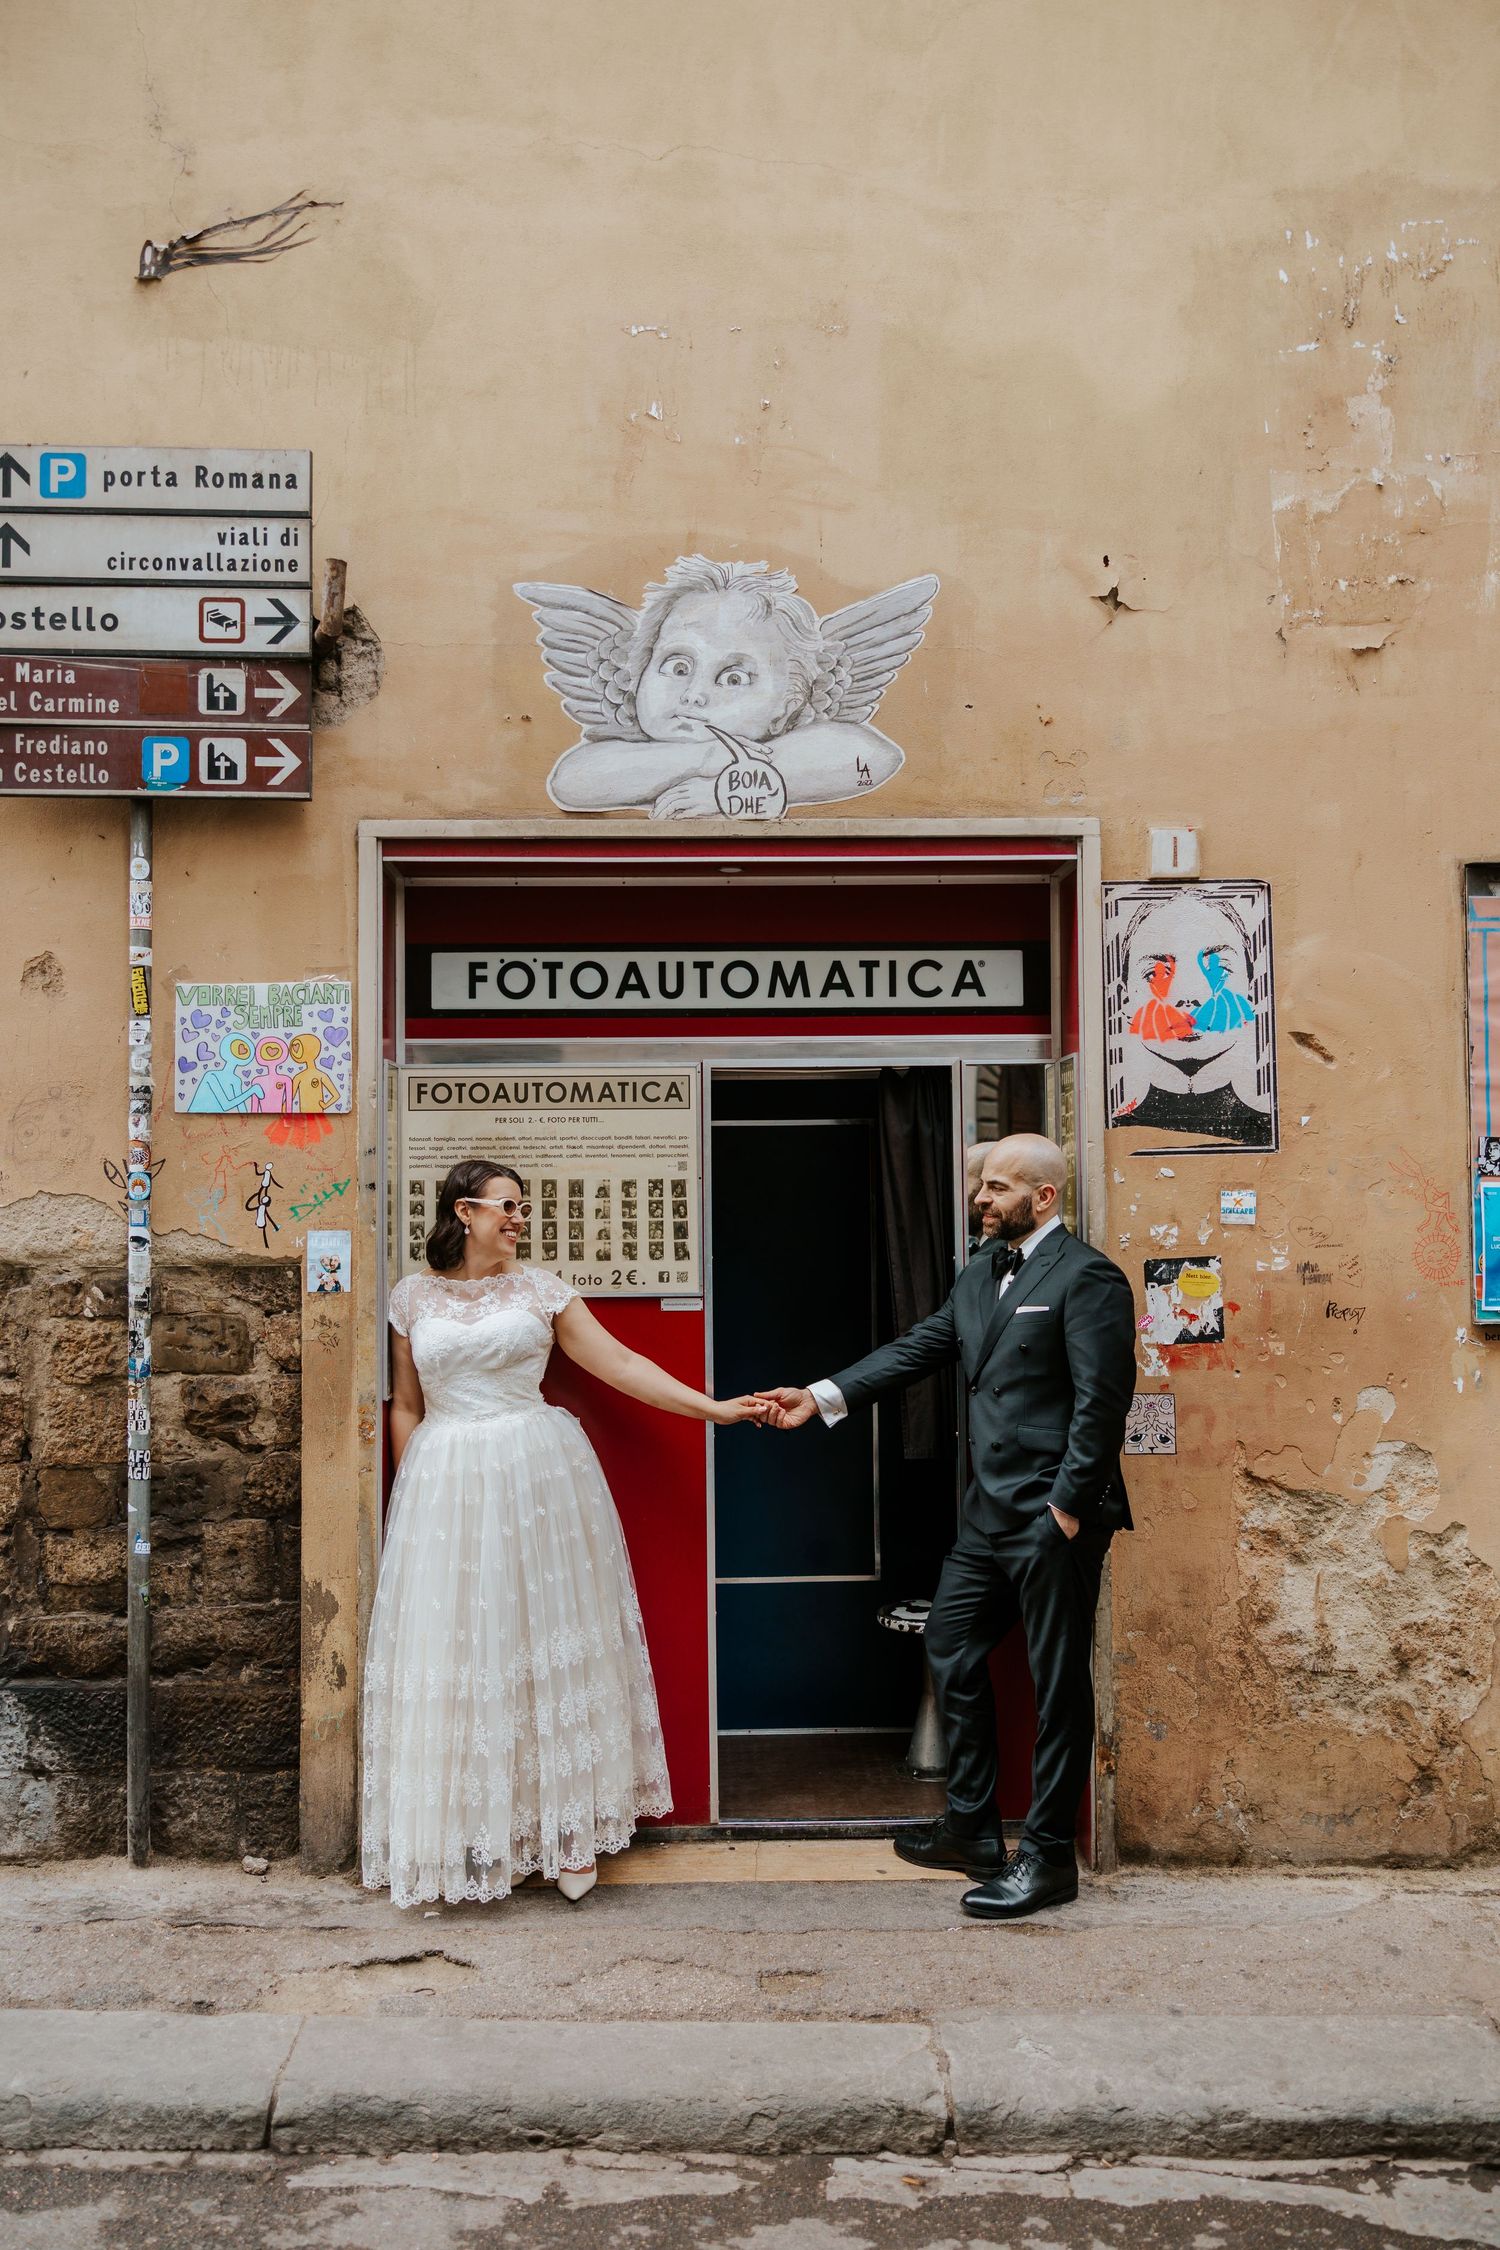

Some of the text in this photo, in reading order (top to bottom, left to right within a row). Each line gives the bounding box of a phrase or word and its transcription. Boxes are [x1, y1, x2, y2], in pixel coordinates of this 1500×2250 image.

[50, 458, 299, 493] P porta Romana
[217, 527, 299, 547] viali di
[107, 551, 299, 573] circonvallazione
[15, 662, 77, 684] Maria
[29, 691, 120, 714] Carmine
[15, 733, 109, 756] Frediano
[153, 743, 179, 778] P
[14, 761, 110, 784] Cestello
[728, 768, 773, 792] BOIA
[233, 1005, 303, 1030] SEMPRE
[572, 1274, 603, 1286] foto
